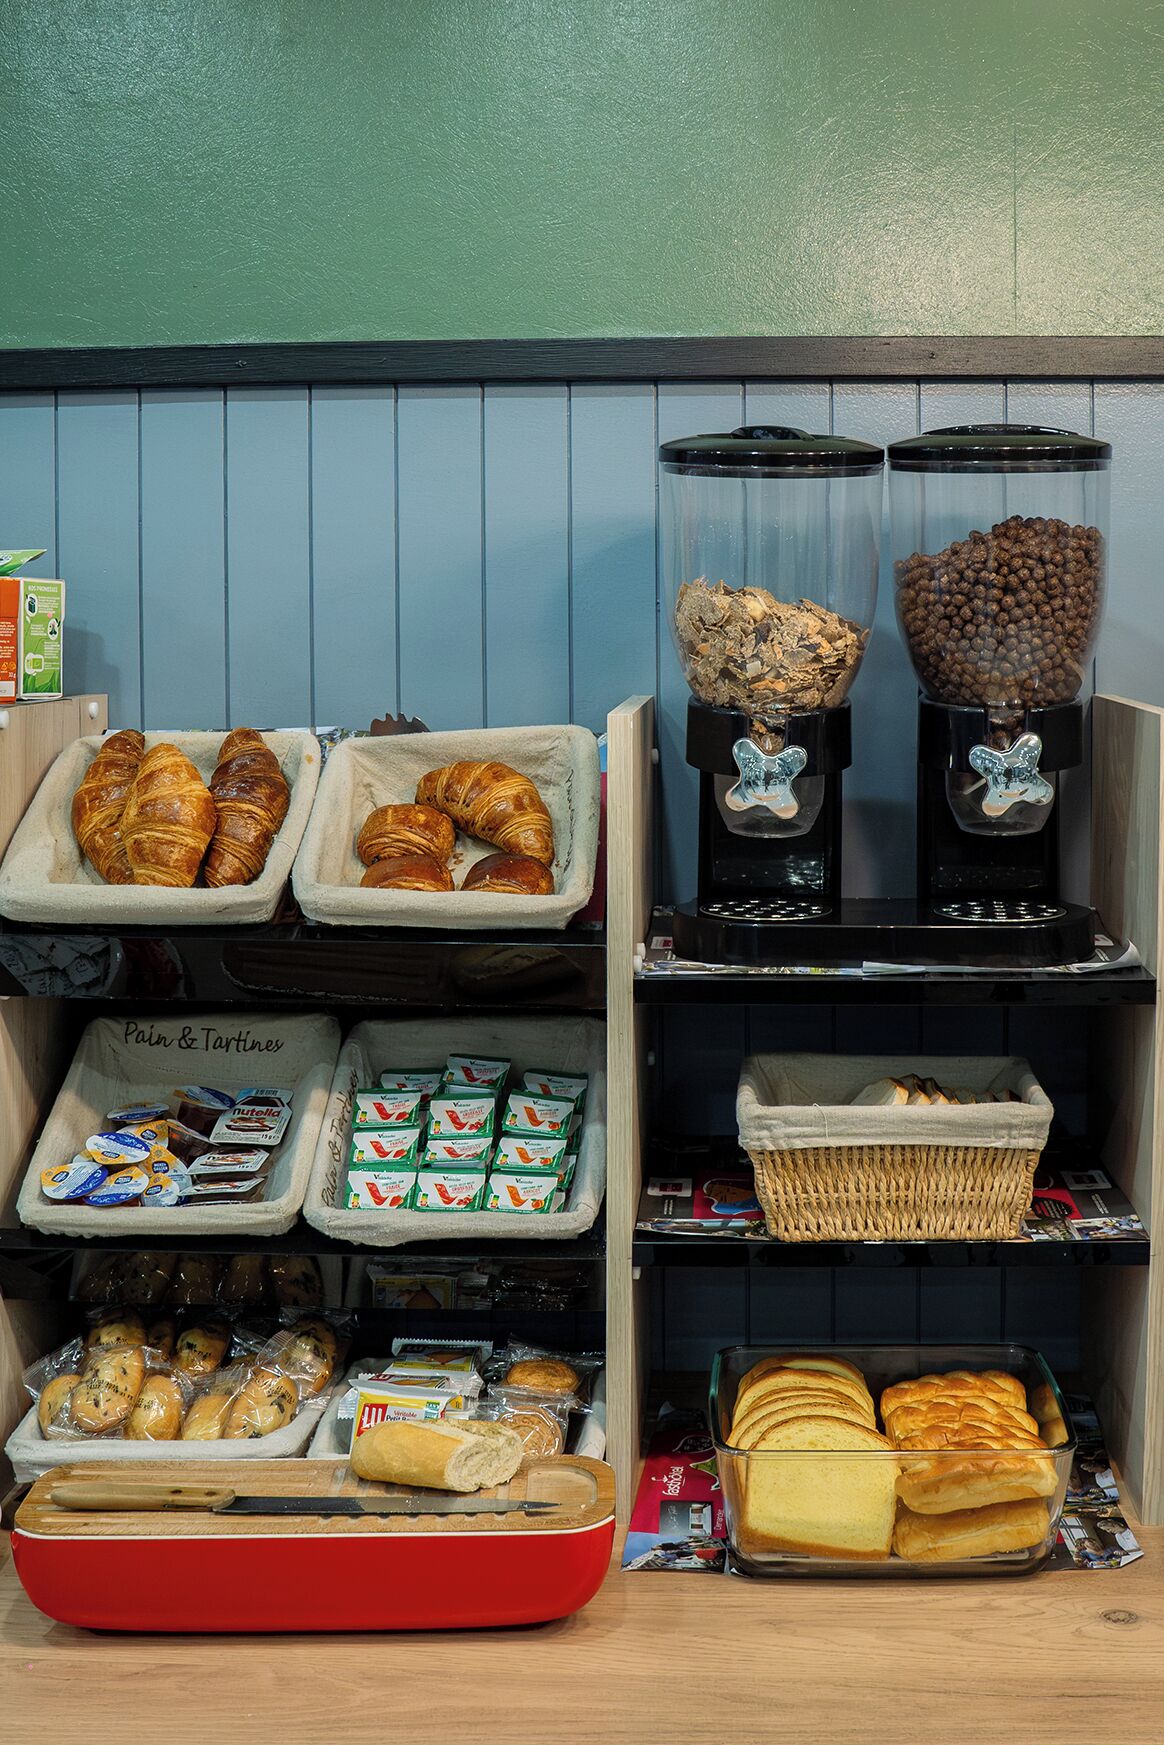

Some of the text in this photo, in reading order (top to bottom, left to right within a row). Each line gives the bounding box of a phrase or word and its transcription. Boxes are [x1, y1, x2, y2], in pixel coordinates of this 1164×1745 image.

[124, 1021, 285, 1053] Pain & Tartines
[232, 1108, 282, 1117] nutella
